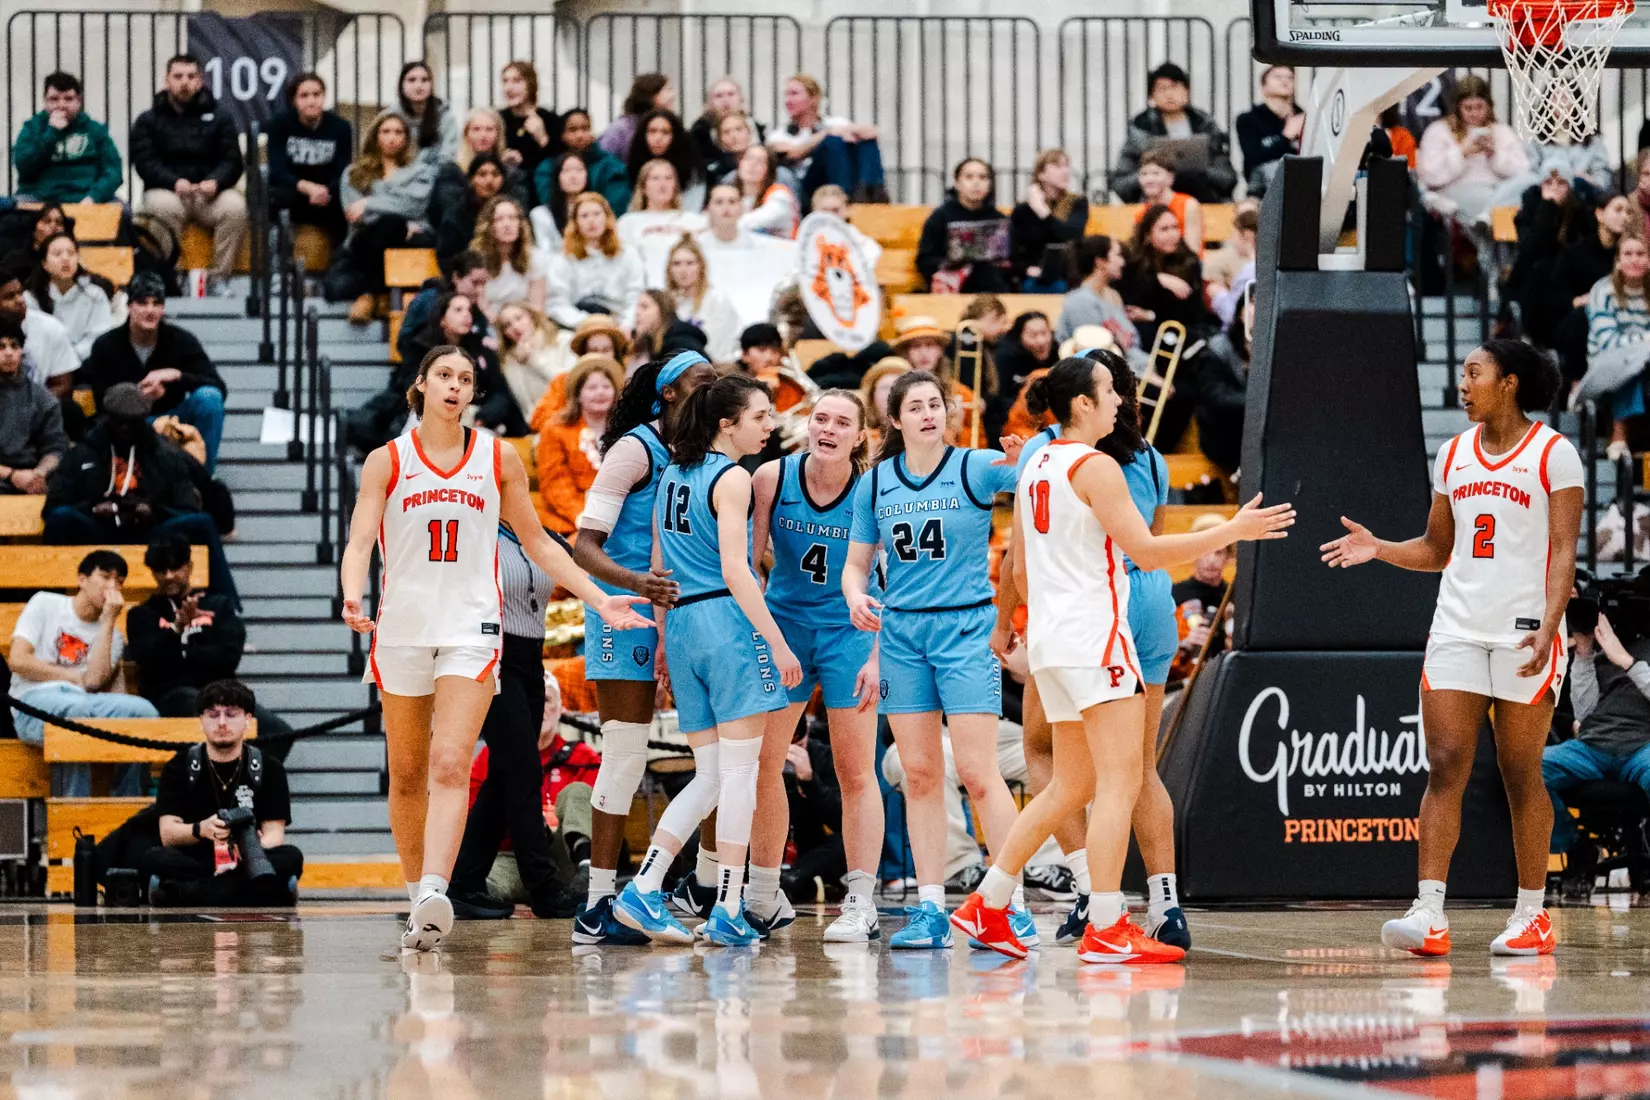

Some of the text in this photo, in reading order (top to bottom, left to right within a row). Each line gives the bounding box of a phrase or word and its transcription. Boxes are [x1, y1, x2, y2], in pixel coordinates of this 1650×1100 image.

[1289, 30, 1340, 41] SPALDING
[205, 56, 288, 101] 109
[1038, 453, 1050, 468] P
[402, 488, 485, 513] PRINCETON
[663, 480, 693, 535] 12
[878, 497, 960, 520] COLUMBIA
[1029, 480, 1050, 534] 10
[1452, 480, 1531, 509] PRINCETON
[428, 519, 459, 562] 11
[778, 516, 850, 540] COLUMBI
[891, 516, 946, 562] 24
[1472, 513, 1496, 559] 2
[800, 542, 828, 585] 4
[602, 624, 614, 662] ONS
[751, 631, 776, 693] LIONS
[1107, 665, 1125, 688] P
[1238, 686, 1430, 816] Graduat
[1303, 783, 1401, 797] BY HILTON
[1284, 818, 1419, 843] PRINCETON
